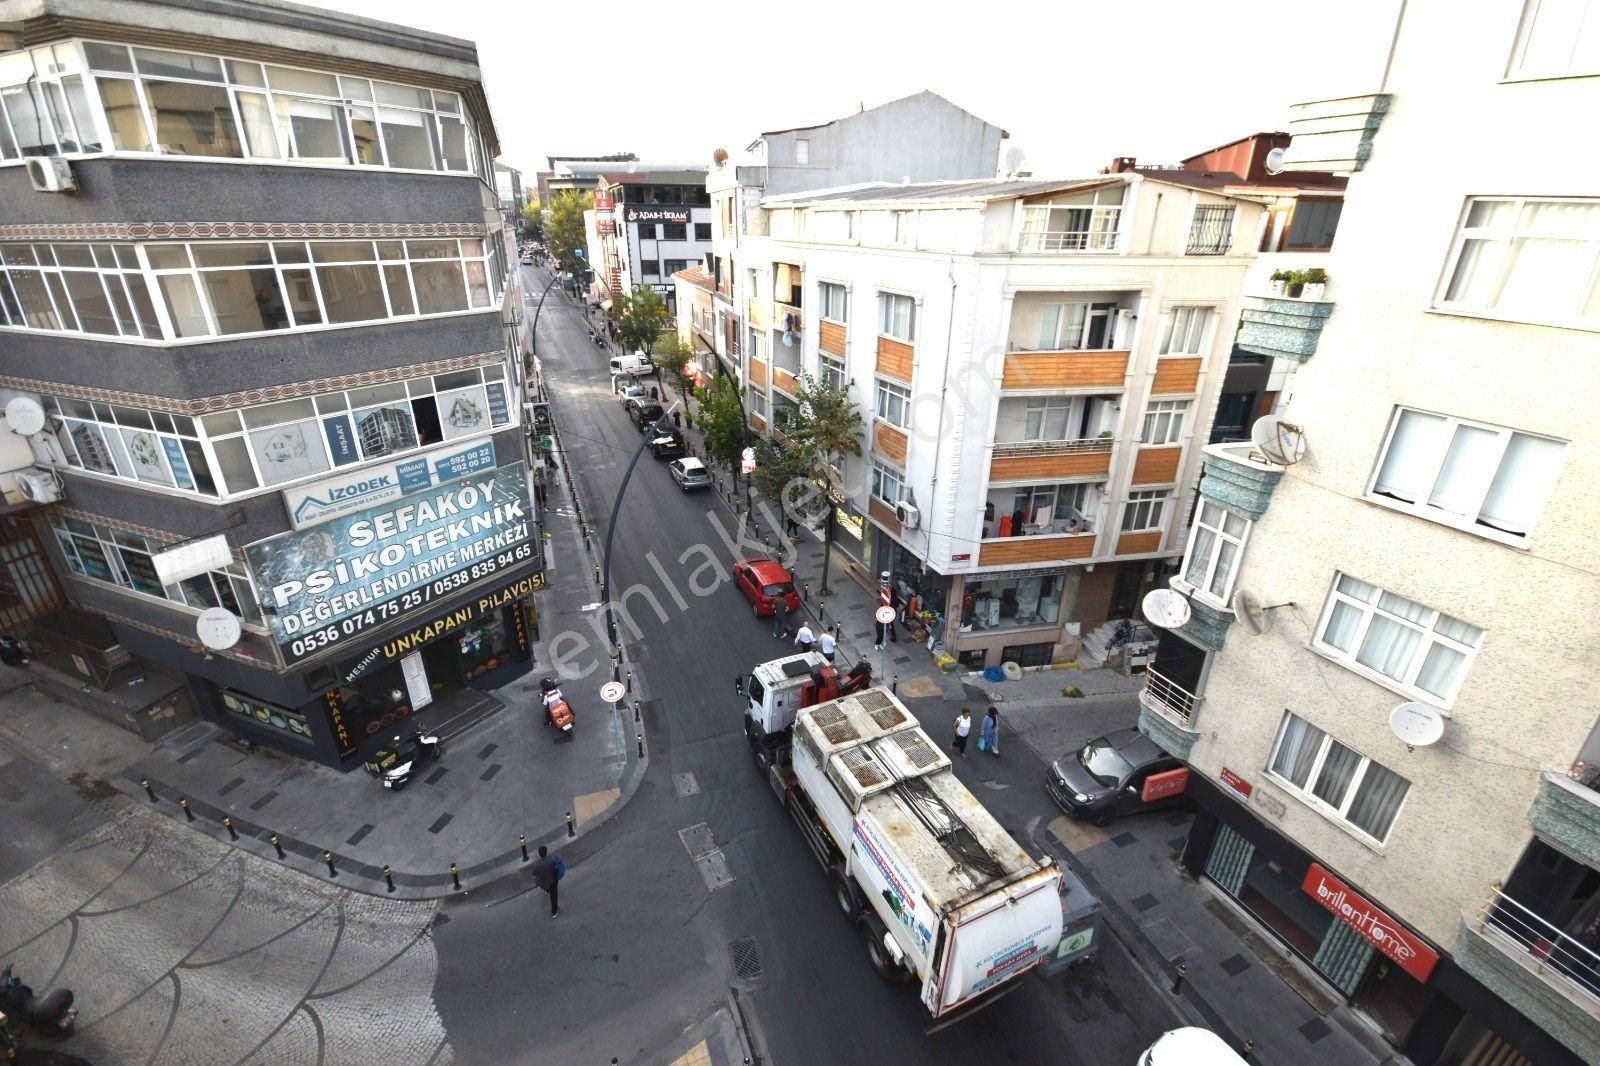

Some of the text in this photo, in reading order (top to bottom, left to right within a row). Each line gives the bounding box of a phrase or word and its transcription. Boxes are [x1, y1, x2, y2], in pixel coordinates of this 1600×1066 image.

[335, 424, 349, 454] İNŞAAT
[450, 452, 465, 464] 592
[467, 449, 478, 460] 00
[479, 447, 490, 458] 22
[451, 456, 491, 473] 592 00 20
[329, 475, 391, 500] İZODEK
[348, 479, 496, 548] SEFAKÖY
[271, 499, 524, 608] PSİKOTEKNİK
[282, 520, 529, 634] DEĞERLENDİRME MERKEZİ
[291, 543, 531, 657] 0536 074 75 25 / 0538 835 94 65
[346, 647, 381, 682] MEŞHUR
[384, 607, 472, 658] UNKAPANI
[479, 571, 545, 613] PİLAVCISI
